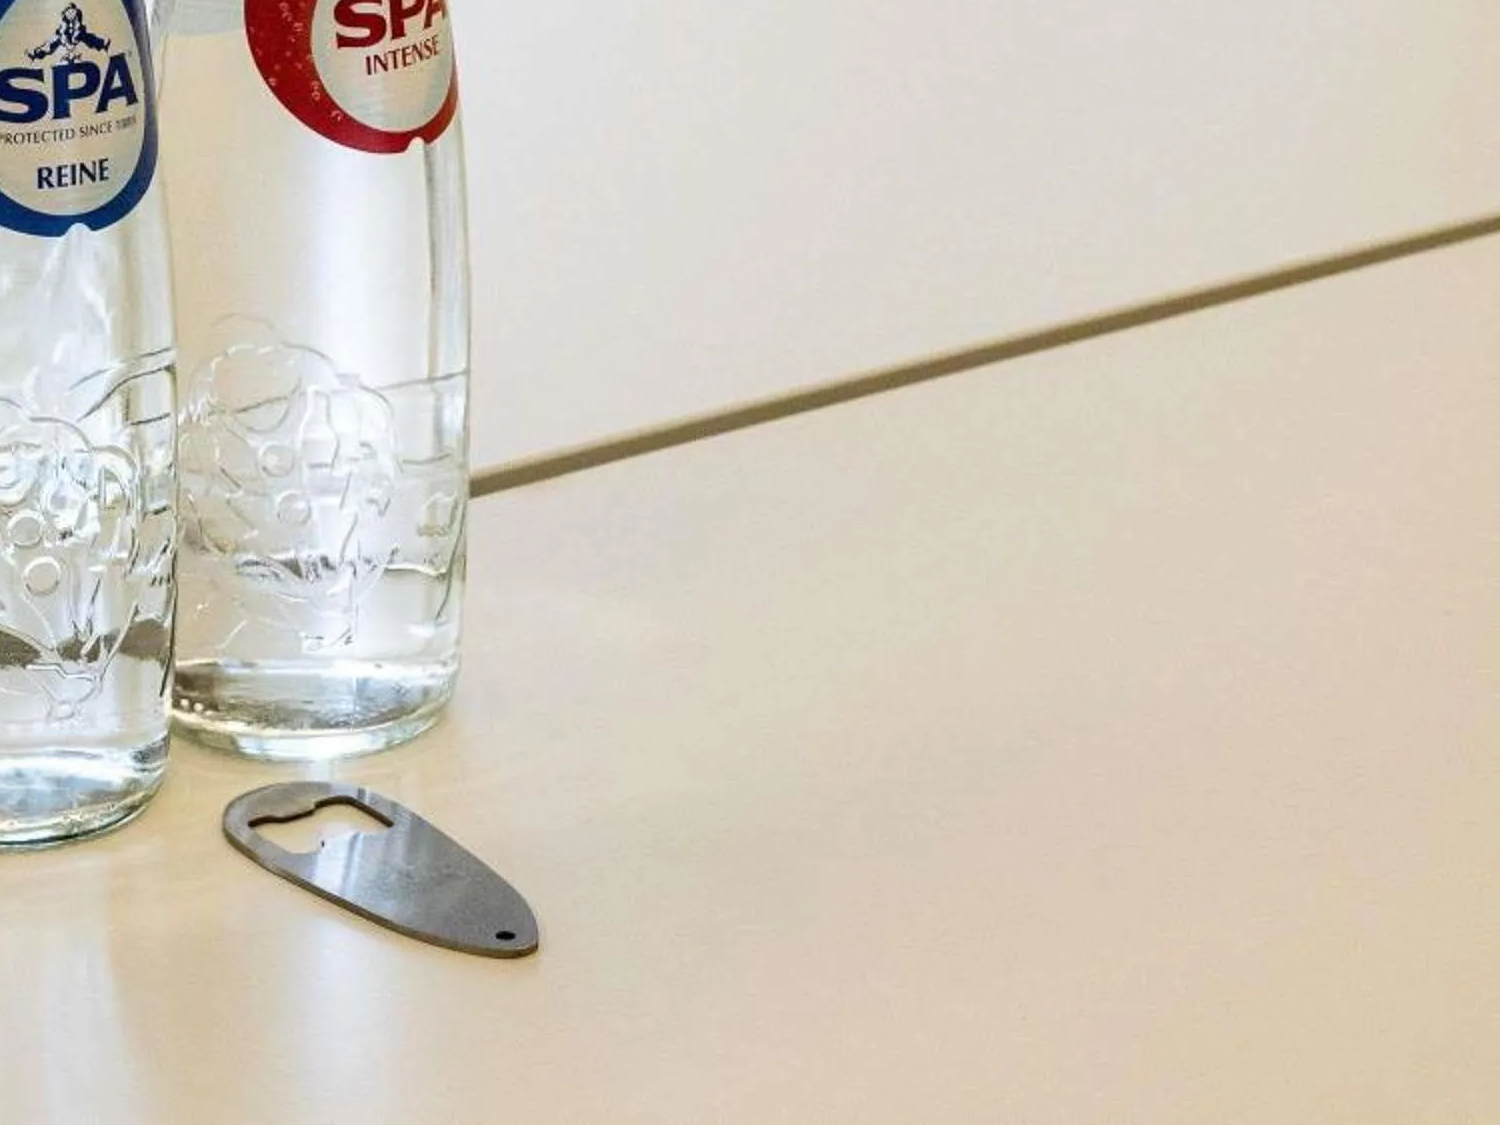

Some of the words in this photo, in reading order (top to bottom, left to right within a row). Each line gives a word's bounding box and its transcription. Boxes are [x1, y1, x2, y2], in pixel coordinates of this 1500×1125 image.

[365, 34, 440, 75] INTENSE
[79, 121, 113, 139] SINCE
[37, 158, 109, 190] REINE
